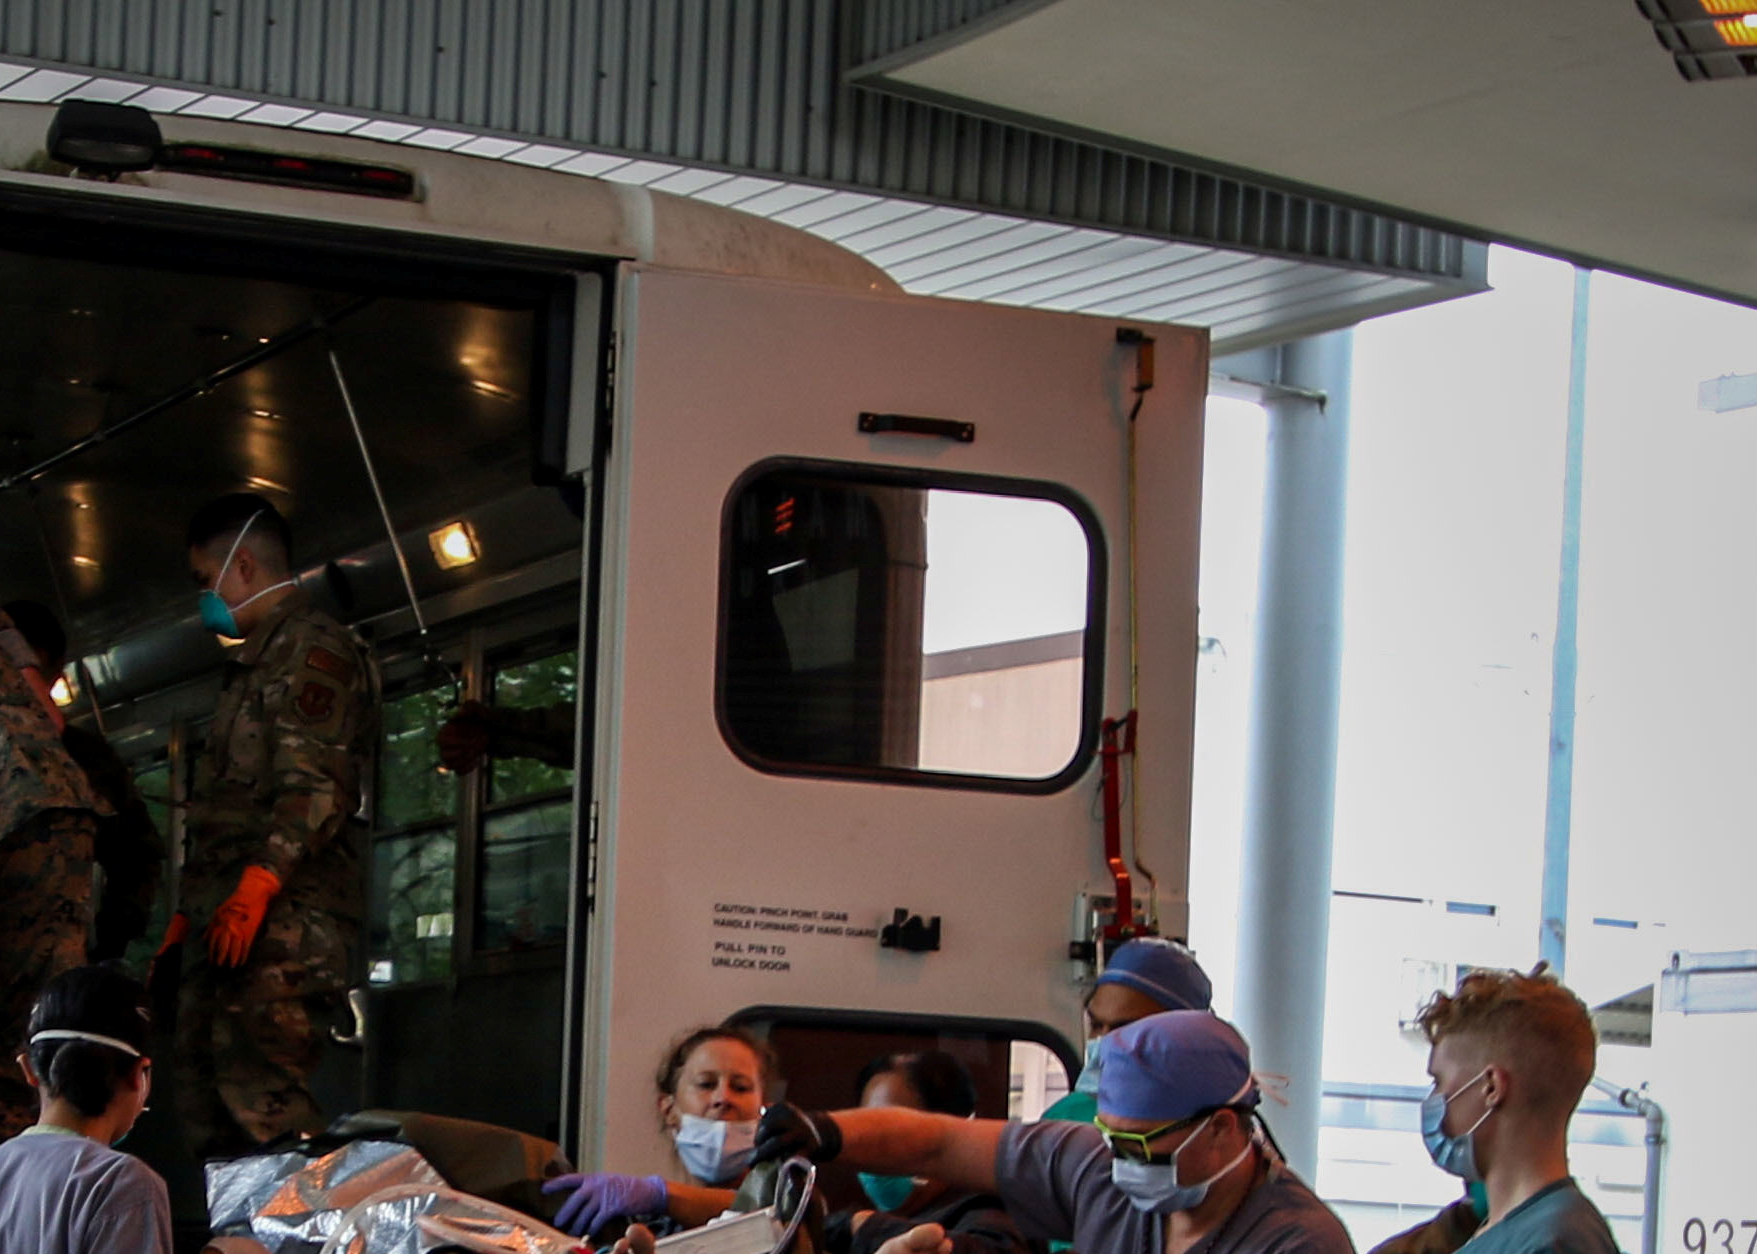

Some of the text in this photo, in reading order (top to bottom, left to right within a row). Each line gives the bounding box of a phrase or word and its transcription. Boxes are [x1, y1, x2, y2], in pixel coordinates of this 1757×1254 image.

[760, 906, 788, 917] PINCH
[822, 911, 848, 921] GRAB
[713, 918, 879, 938] HANDLE FORWARD OF HAND GUARD
[715, 941, 786, 956] PULL PIN TO
[712, 957, 790, 972] UNLOCK DOOR
